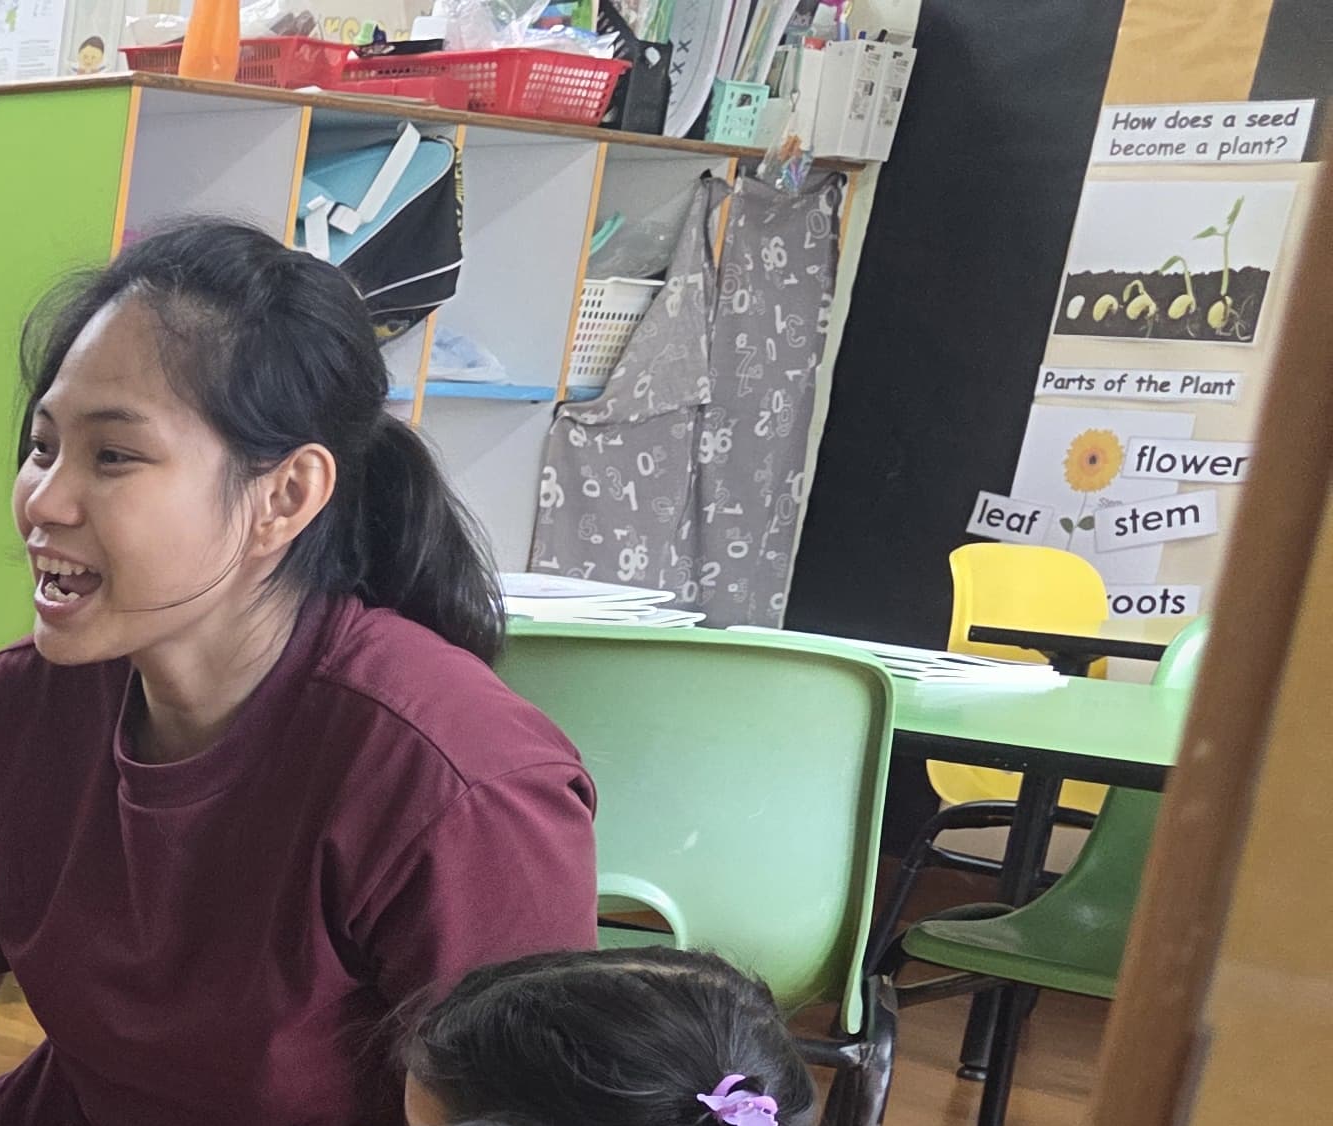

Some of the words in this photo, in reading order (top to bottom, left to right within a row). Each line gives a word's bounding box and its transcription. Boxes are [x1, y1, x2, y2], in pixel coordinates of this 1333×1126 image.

[1111, 111, 1157, 131] How
[1164, 110, 1214, 130] does
[1222, 114, 1237, 128] a
[1245, 106, 1300, 127] seed
[1109, 138, 1187, 157] become
[1195, 141, 1208, 155] a
[1217, 135, 1289, 161] plant?
[1042, 371, 1096, 391] Parts
[1104, 373, 1129, 393] of
[1135, 374, 1172, 393] the
[1180, 375, 1237, 396] Plant
[1135, 444, 1248, 477] flower
[976, 499, 1041, 536] leaf
[1114, 503, 1201, 537] stem
[1107, 588, 1186, 615] oots
